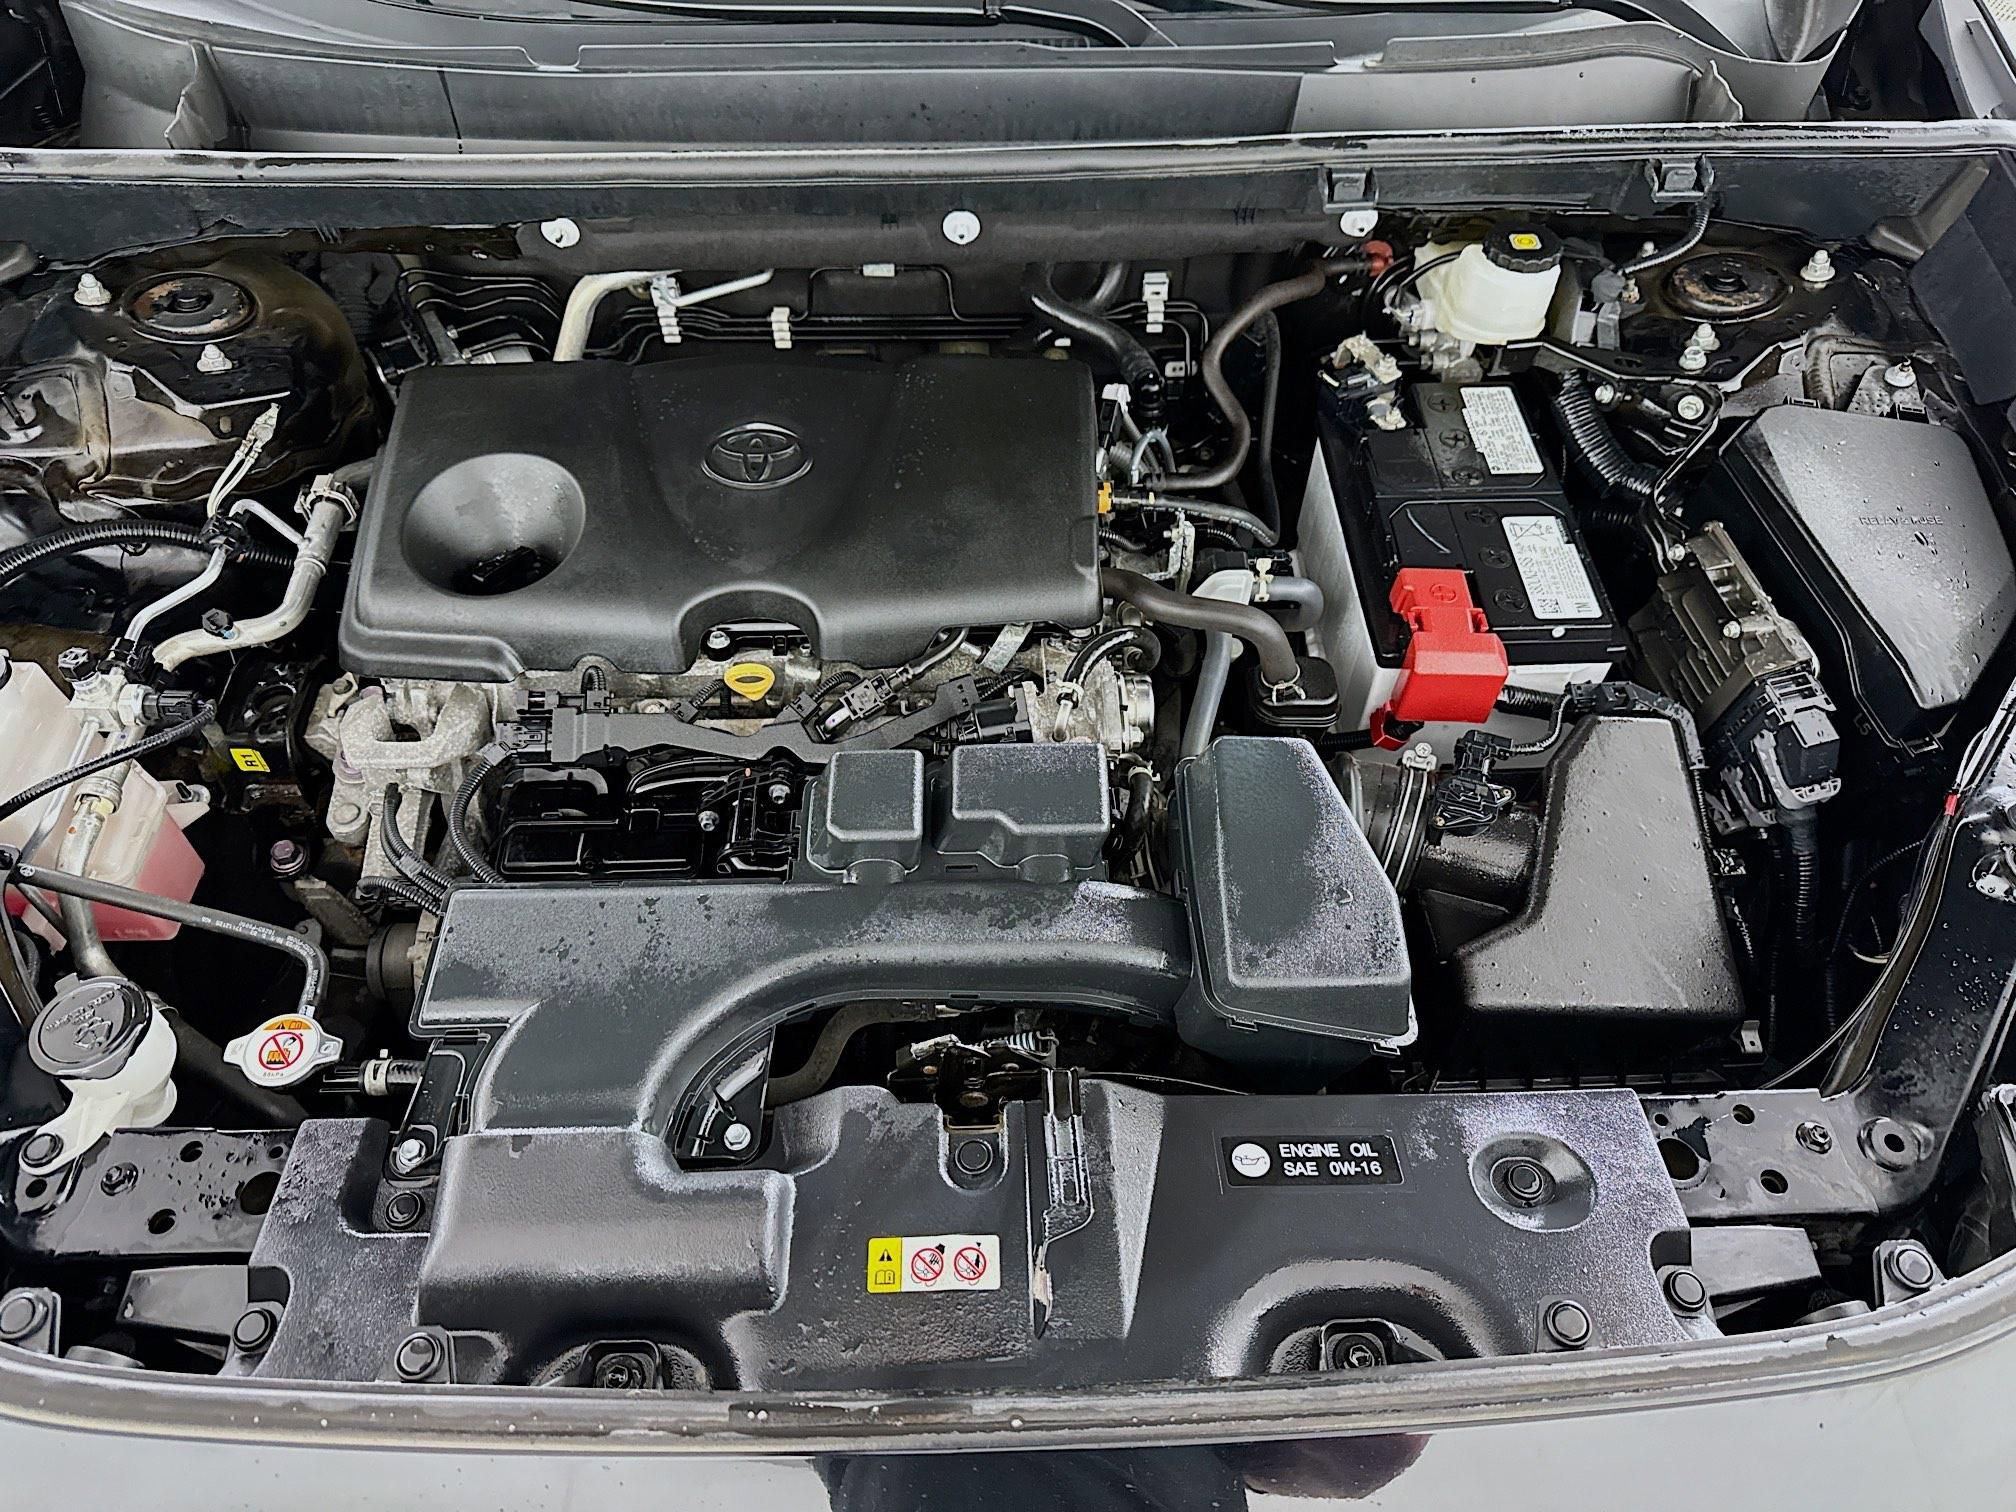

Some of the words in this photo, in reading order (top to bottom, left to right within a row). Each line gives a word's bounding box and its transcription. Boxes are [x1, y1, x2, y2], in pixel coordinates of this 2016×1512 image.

[1278, 1143, 1341, 1158] ENGINE
[1349, 1143, 1379, 1158] OIL
[1283, 1161, 1320, 1177] SAE
[1328, 1161, 1383, 1176] 0W-16
